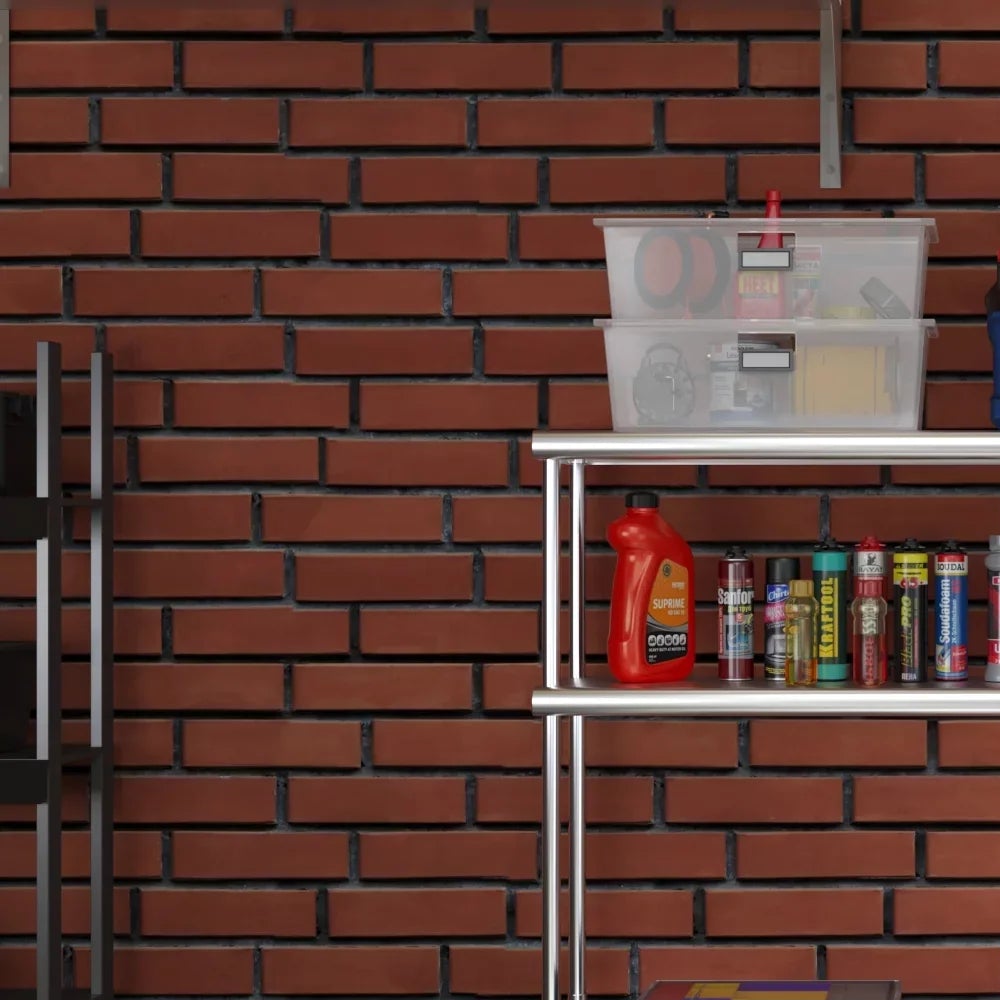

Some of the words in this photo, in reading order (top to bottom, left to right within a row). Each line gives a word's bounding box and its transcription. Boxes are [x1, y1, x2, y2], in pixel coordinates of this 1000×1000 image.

[652, 598, 685, 609] SUPRIME
[718, 588, 754, 604] Sanfor
[900, 596, 912, 628] PRO
[939, 579, 950, 644] Soudafoam
[819, 578, 834, 657] KRAFTOOL
